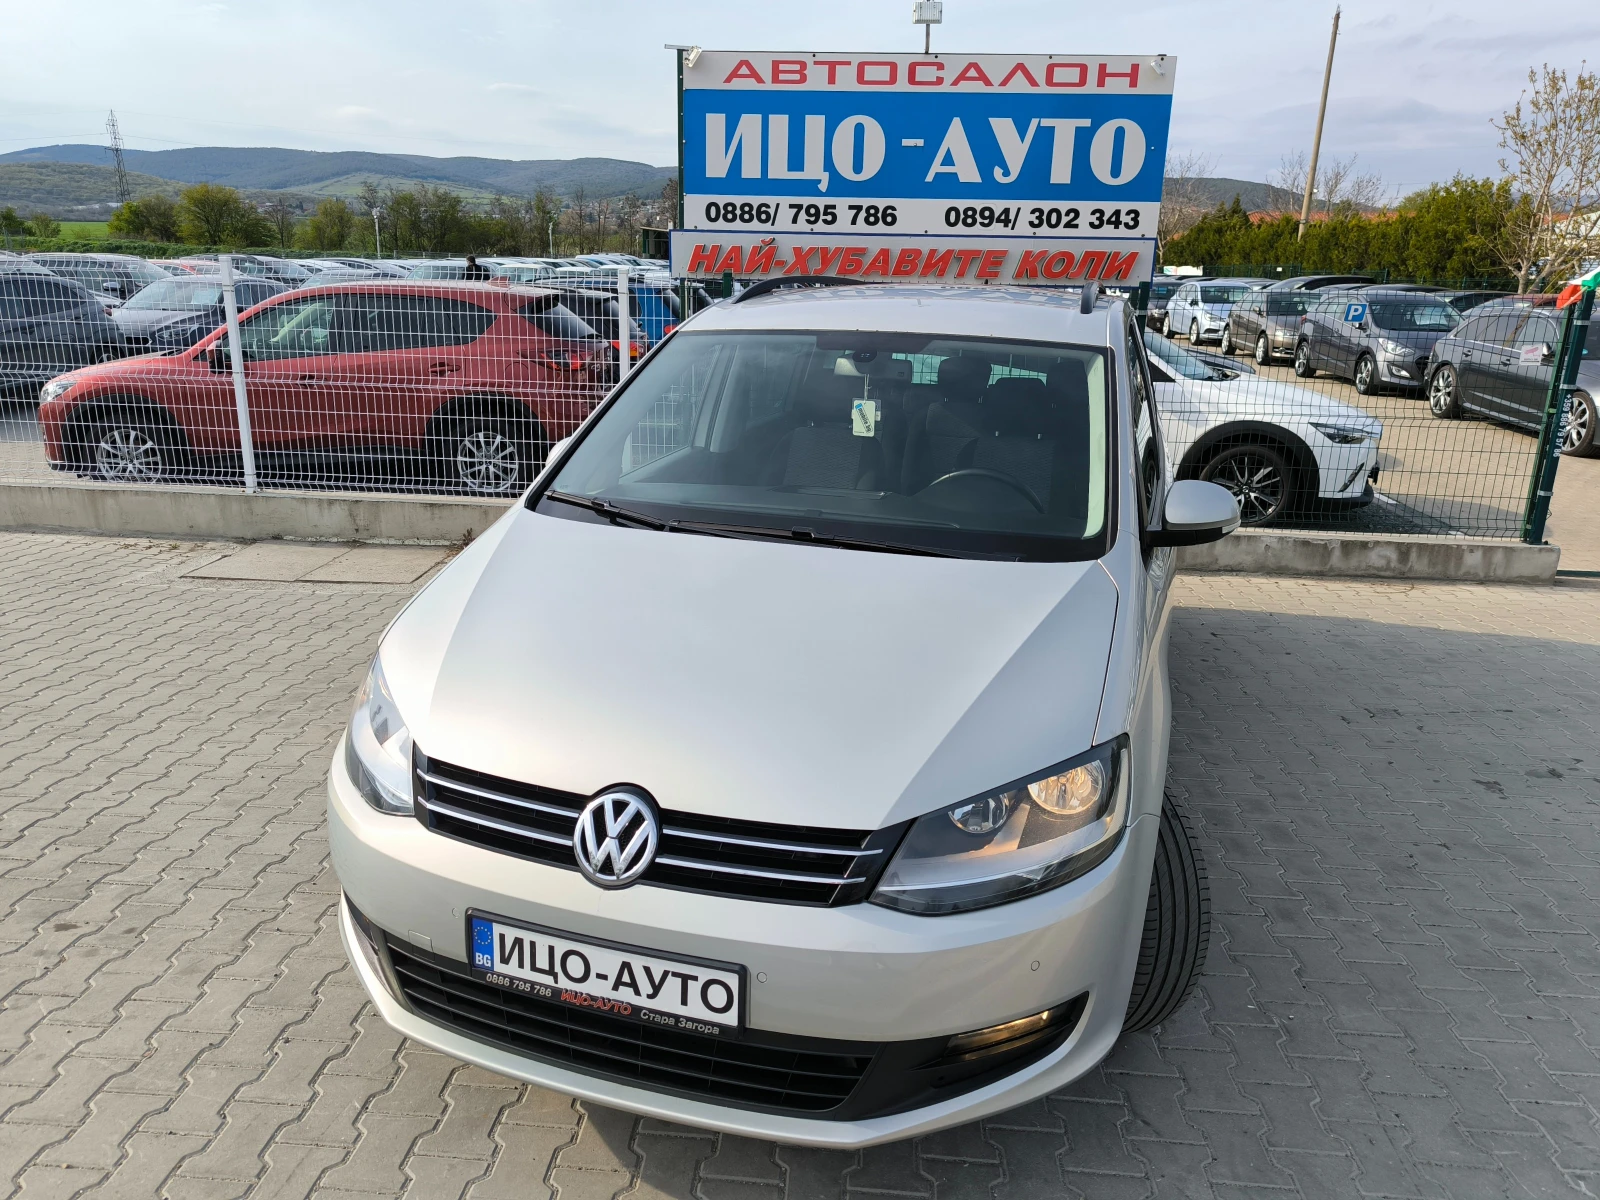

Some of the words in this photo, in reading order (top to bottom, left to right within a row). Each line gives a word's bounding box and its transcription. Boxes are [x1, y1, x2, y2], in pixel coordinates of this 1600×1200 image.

[722, 58, 1140, 88] АВТОСАЛОН
[704, 202, 780, 226] 0886/
[788, 203, 838, 226] 795
[848, 204, 898, 227] 786
[944, 206, 1020, 230] 0894/
[1028, 207, 1080, 229] 302
[1088, 207, 1140, 230] 343
[687, 237, 1009, 280] НАЙ-ХУБАВИТЕ
[1013, 249, 1140, 281] КОЛИ
[1347, 305, 1363, 321] P
[475, 952, 492, 968] BG
[486, 973, 511, 988] 0886
[512, 979, 531, 993] 795
[533, 984, 552, 998] 786
[498, 932, 735, 1015] ИЦО-АУТО
[640, 1009, 677, 1028] Стара
[678, 1016, 720, 1035] Загора
